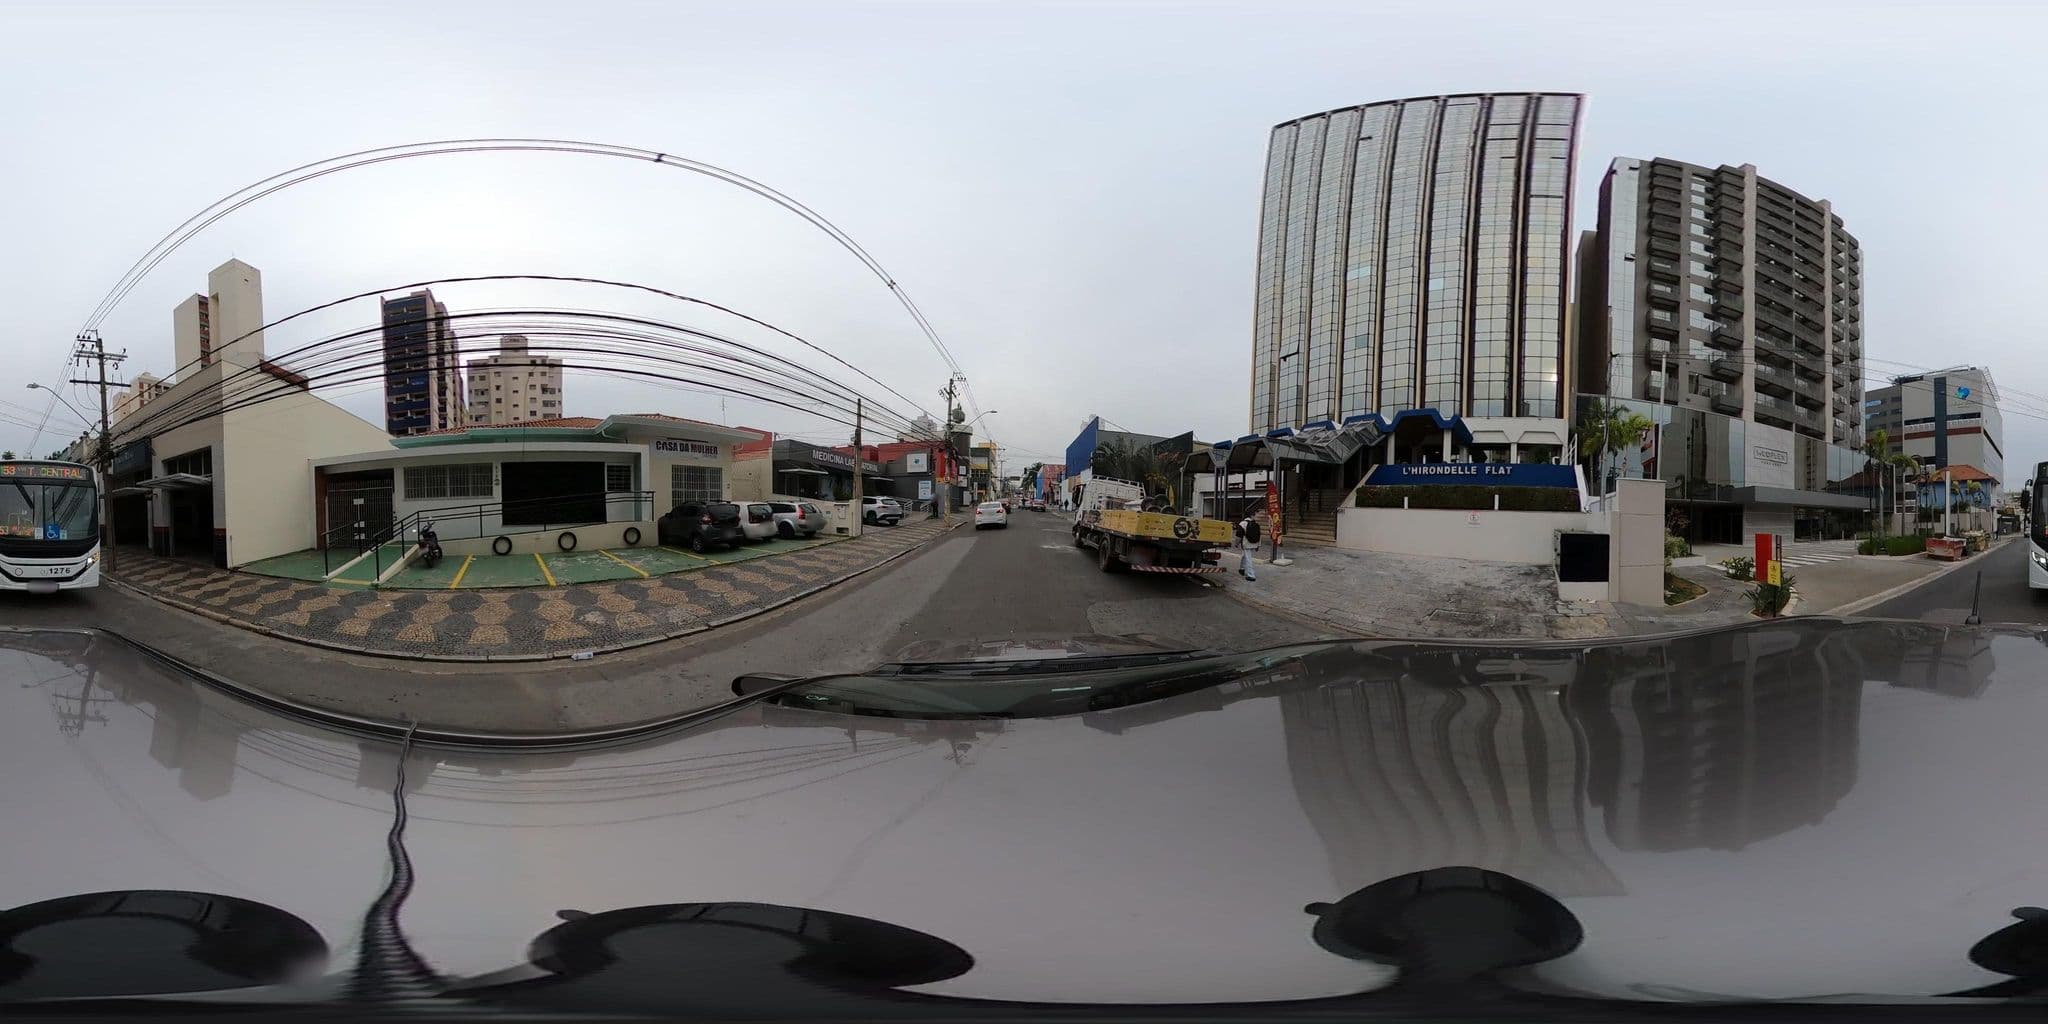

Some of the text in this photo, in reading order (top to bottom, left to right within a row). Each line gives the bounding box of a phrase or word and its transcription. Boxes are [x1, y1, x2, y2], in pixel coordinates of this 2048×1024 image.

[656, 441, 718, 455] CASA DA MULHER
[812, 449, 844, 465] MEDICINA
[40, 467, 83, 479] CENTRAL
[1403, 466, 1513, 475] L'HIRONDELLE FLAT
